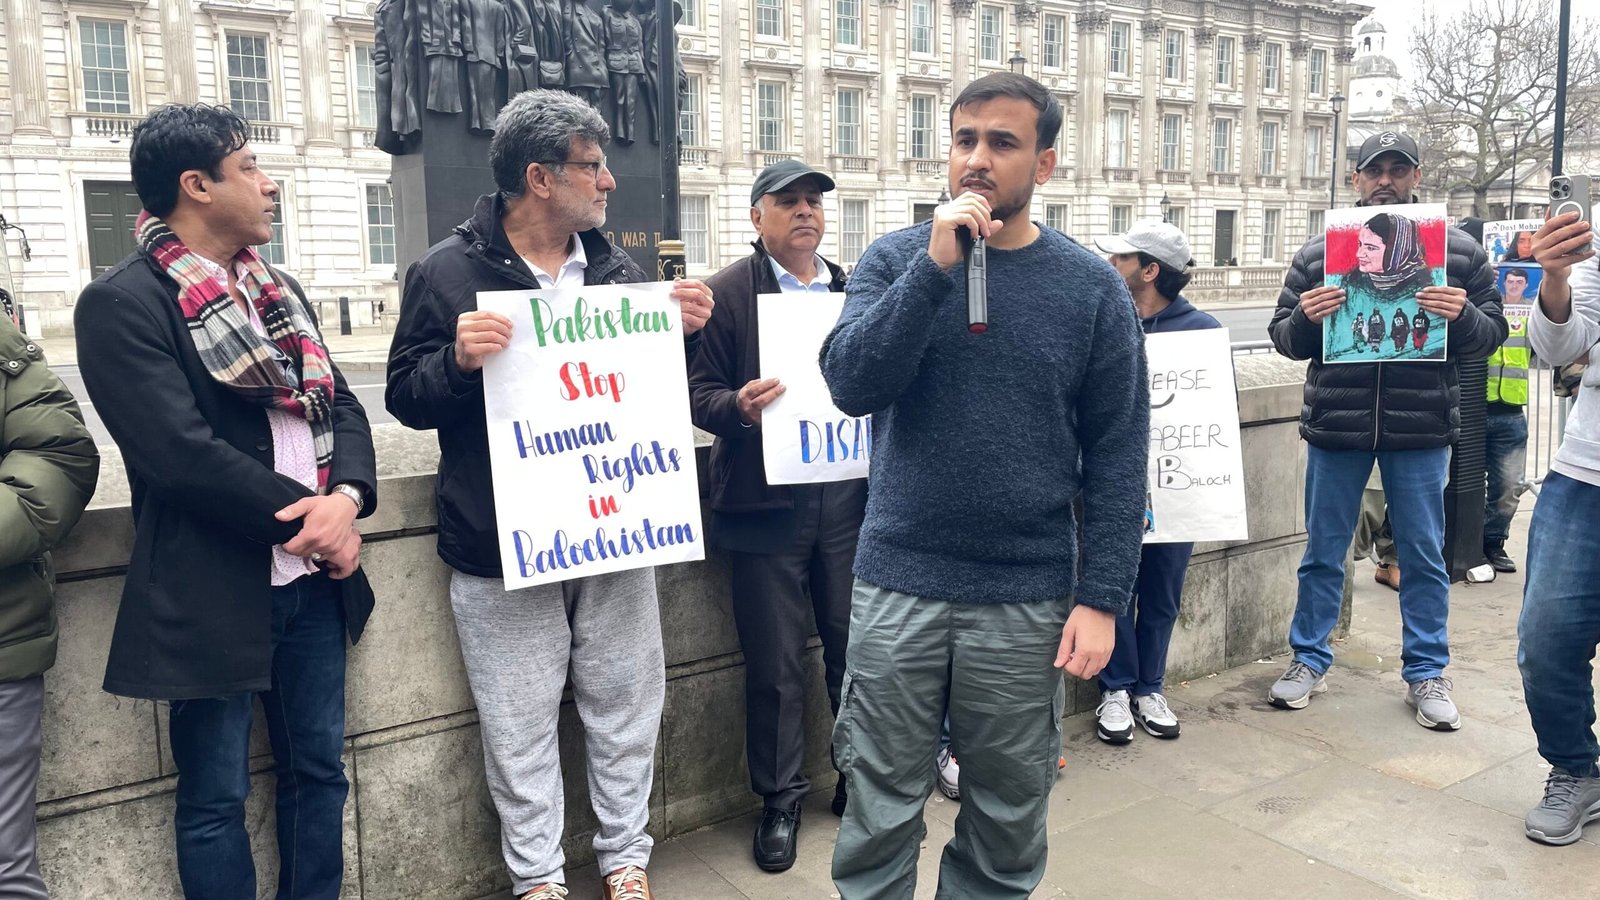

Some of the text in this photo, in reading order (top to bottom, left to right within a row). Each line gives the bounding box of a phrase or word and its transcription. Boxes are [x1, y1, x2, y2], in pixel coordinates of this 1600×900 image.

[622, 231, 647, 247] WAR
[654, 232, 661, 247] II
[529, 296, 673, 347] Pakistan
[559, 361, 626, 403] Stop
[1152, 369, 1212, 390] EASE
[513, 420, 617, 459] Human
[1150, 424, 1229, 451] ABEER
[582, 440, 681, 493] Rights
[1157, 455, 1231, 490] BALOCH
[588, 494, 621, 519] in
[512, 518, 698, 578] Balochistan
